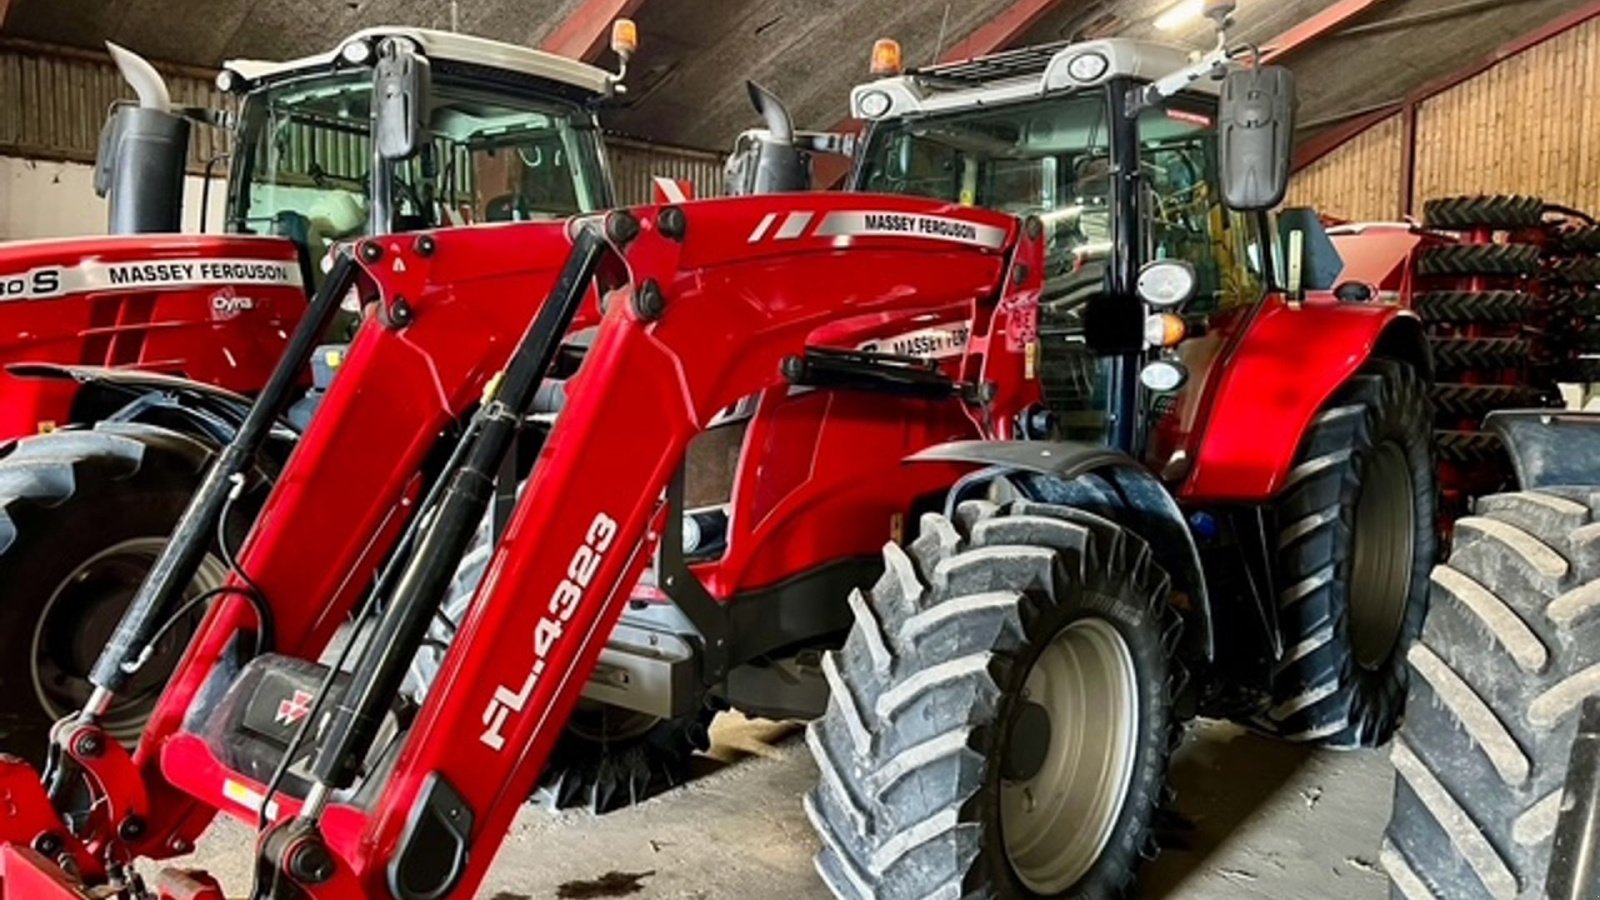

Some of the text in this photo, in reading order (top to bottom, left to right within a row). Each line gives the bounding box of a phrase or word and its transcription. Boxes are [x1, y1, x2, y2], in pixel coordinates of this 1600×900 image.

[864, 214, 976, 240] MASSEY FERGUSON
[32, 270, 59, 294] S
[109, 264, 194, 284] MASSEY
[200, 263, 287, 280] FERGUSON
[480, 512, 618, 751] FL.4323
